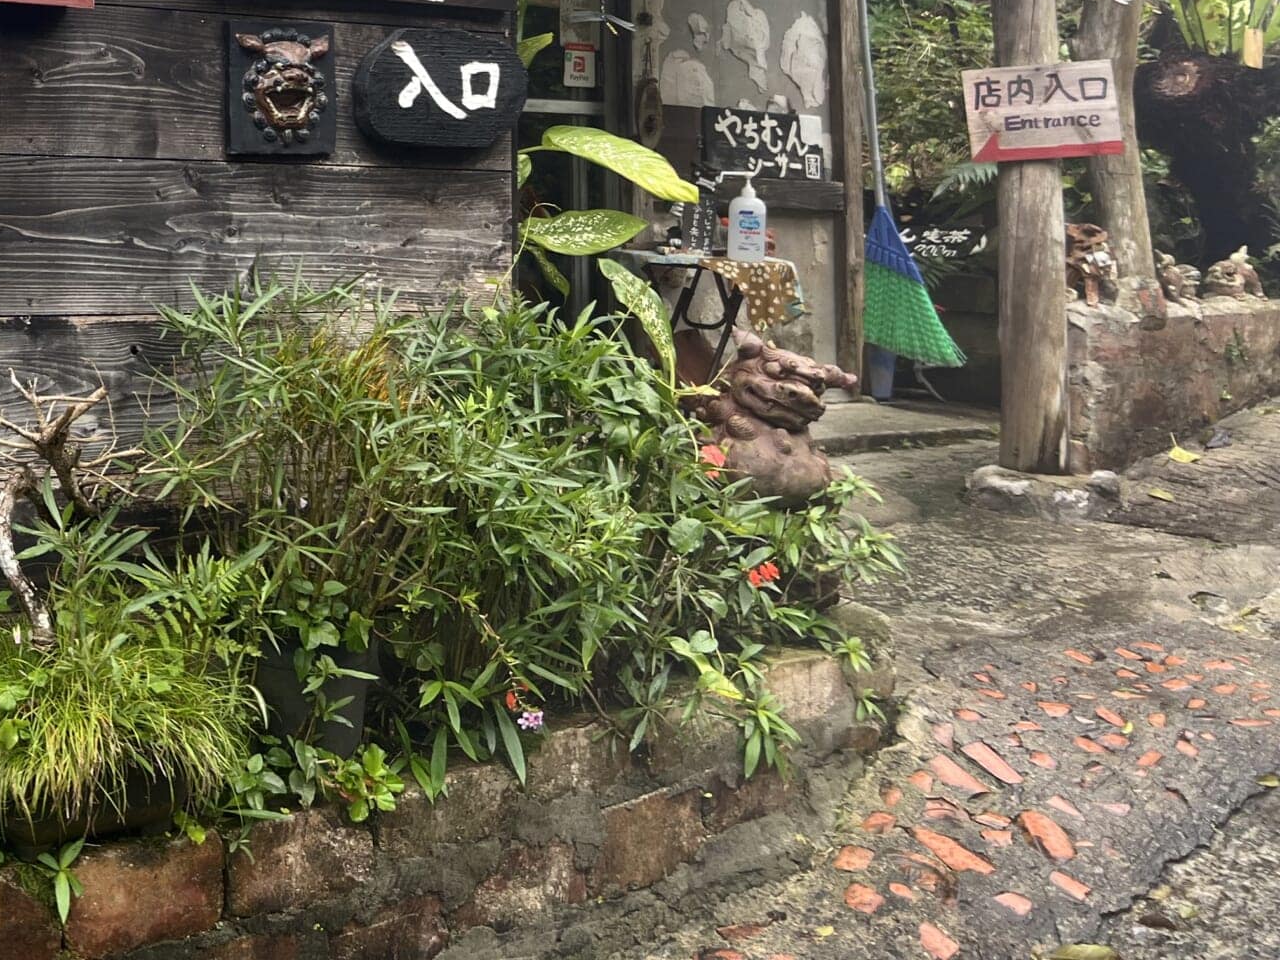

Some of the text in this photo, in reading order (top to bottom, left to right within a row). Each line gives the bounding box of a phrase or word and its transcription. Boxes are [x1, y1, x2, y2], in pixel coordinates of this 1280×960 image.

[391, 40, 501, 120] 入口
[974, 72, 1108, 111] 店内入口
[714, 109, 808, 156] やちむん
[1004, 114, 1101, 131] Entrance
[747, 153, 821, 179] シーサー園
